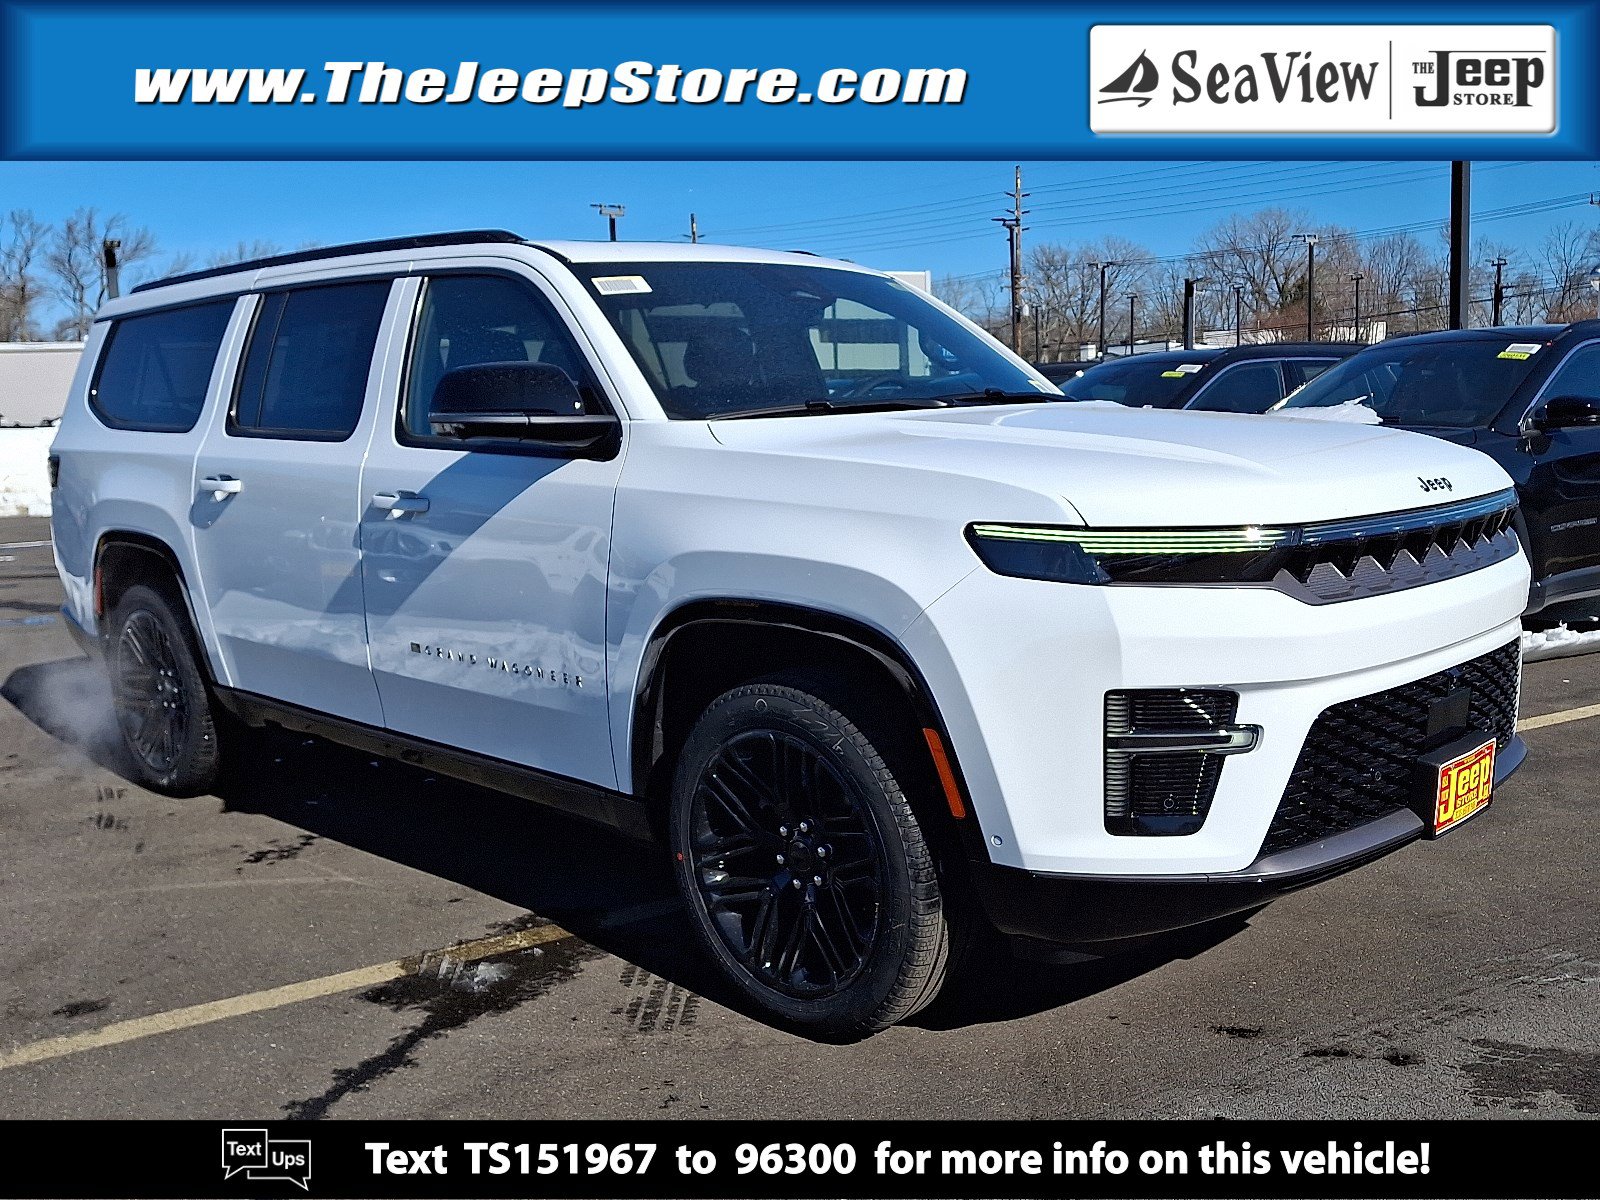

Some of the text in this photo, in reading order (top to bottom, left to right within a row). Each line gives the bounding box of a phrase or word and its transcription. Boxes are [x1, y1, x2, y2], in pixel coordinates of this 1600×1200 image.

[1417, 476, 1453, 492] Jeep
[424, 645, 583, 688] GRAND WAGONEER
[1439, 755, 1491, 822] Jeep
